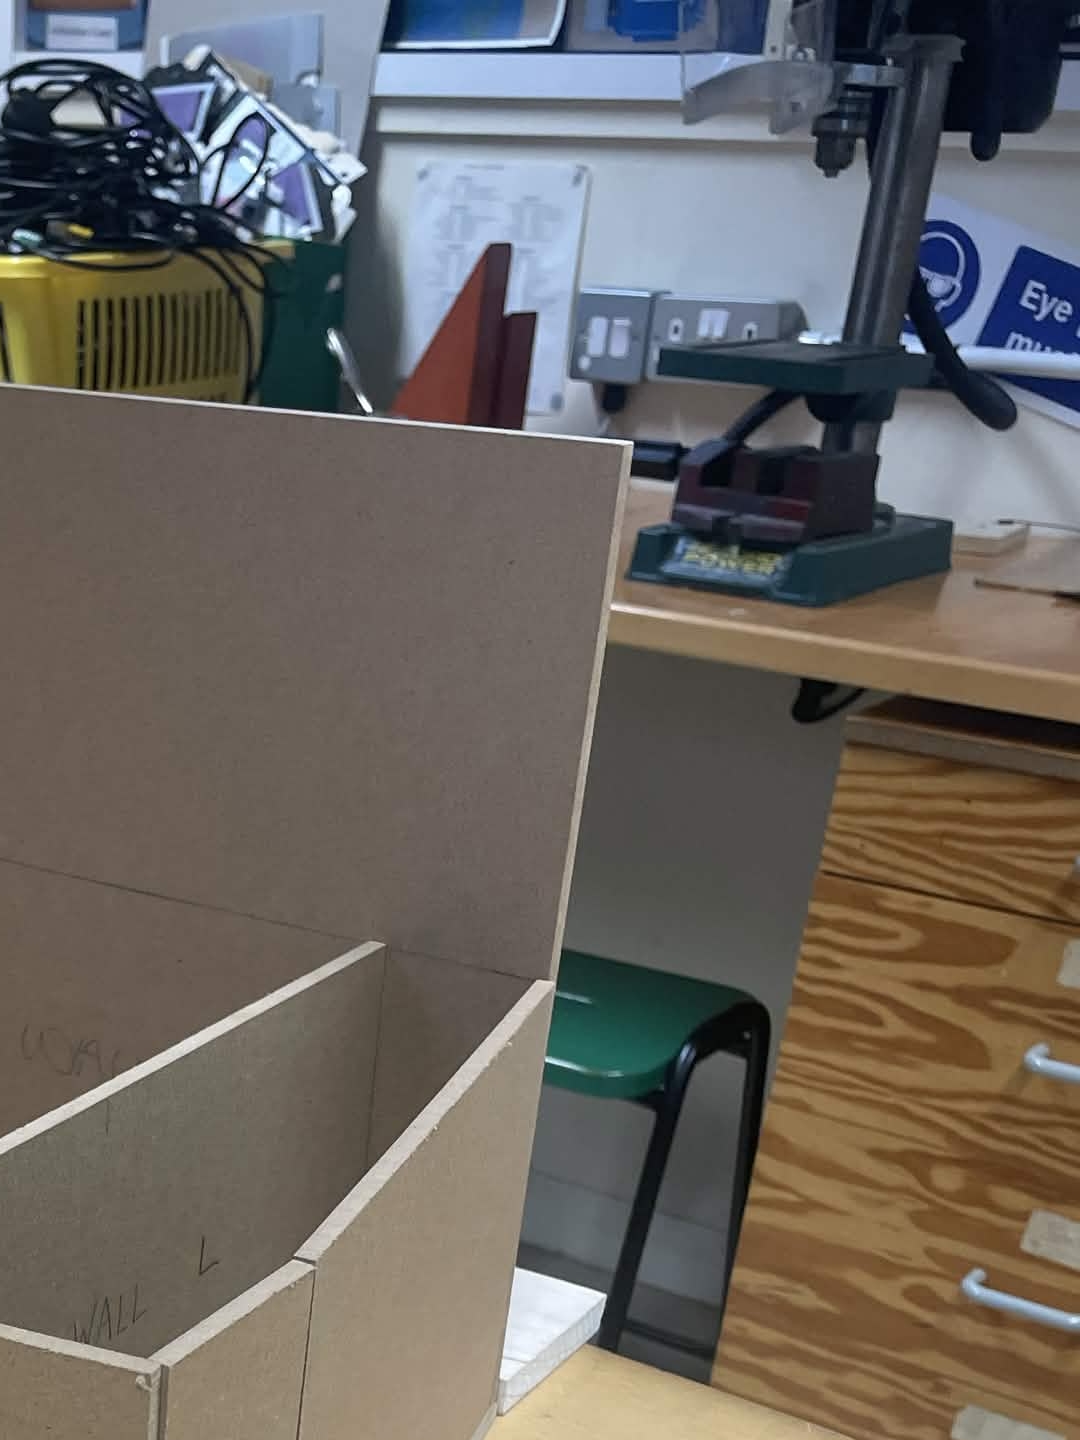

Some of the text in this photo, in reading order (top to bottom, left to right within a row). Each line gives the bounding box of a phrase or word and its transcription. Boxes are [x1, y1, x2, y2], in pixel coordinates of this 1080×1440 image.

[1019, 279, 1073, 322] Eye
[73, 1235, 220, 1345] WALL L
